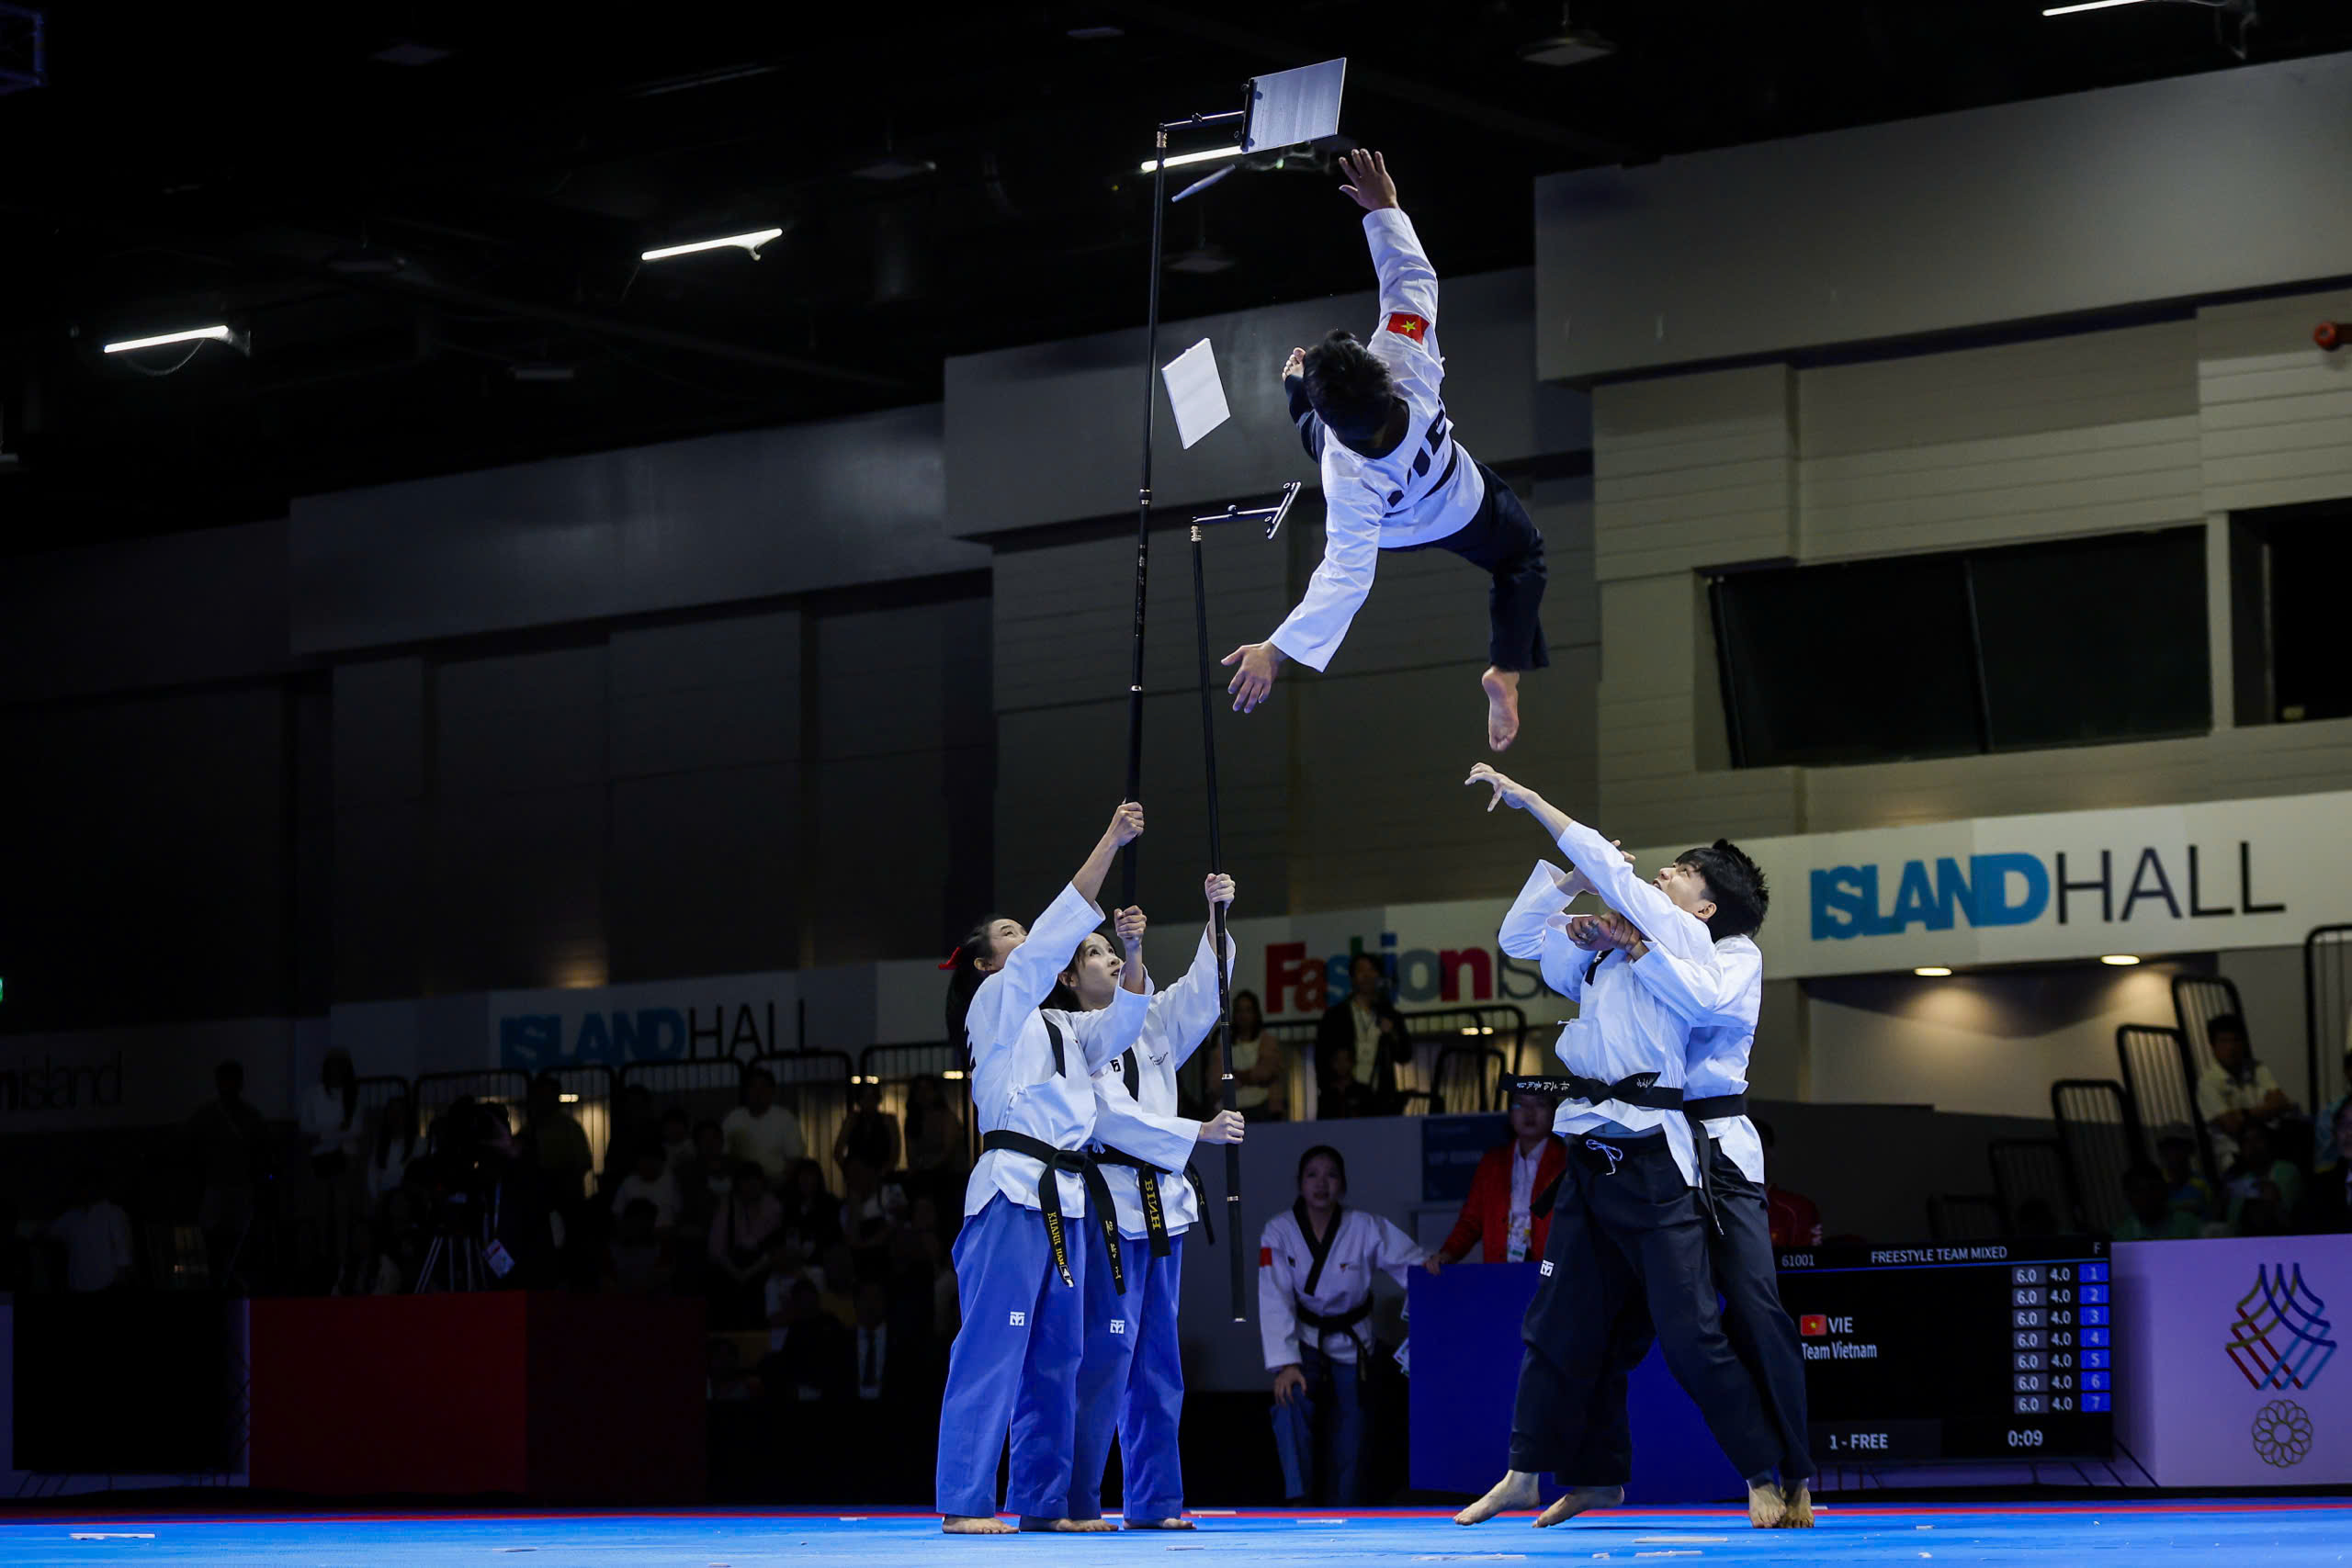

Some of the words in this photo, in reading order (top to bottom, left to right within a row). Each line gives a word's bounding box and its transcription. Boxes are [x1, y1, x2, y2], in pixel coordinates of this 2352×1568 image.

[1810, 852, 2049, 940] ISLAND
[2057, 841, 2286, 924] HALL
[500, 1008, 685, 1072] ISLAND
[690, 998, 820, 1061] HALL
[1781, 1254, 1815, 1268] 61001
[1871, 1248, 1934, 1264] FREESTYLE
[1937, 1247, 1969, 1261] TEAM
[1971, 1246, 2007, 1259] MIXED
[2016, 1269, 2037, 1283] 6.0
[2049, 1267, 2071, 1281] 4.0
[2089, 1266, 2099, 1280] 1
[2017, 1291, 2037, 1304] 6.0
[2050, 1289, 2071, 1303] 4.0
[2089, 1287, 2099, 1302] 2
[1827, 1316, 1854, 1335] VIE
[2017, 1312, 2038, 1325] 6.0
[2050, 1310, 2072, 1324] 4.0
[2090, 1308, 2099, 1323] 3
[2018, 1333, 2038, 1347] 6.0
[2051, 1331, 2072, 1345] 4.0
[2090, 1329, 2100, 1344] 4
[1802, 1342, 1830, 1360] Team
[1831, 1340, 1878, 1359] Vietnam
[2018, 1355, 2039, 1369] 6.0
[2051, 1353, 2073, 1367] 4.0
[2091, 1351, 2100, 1366] 5
[2018, 1376, 2039, 1390] 6.0
[2052, 1374, 2073, 1388] 4.0
[2091, 1372, 2100, 1387] 6
[2018, 1397, 2040, 1412] 6.0
[2052, 1395, 2074, 1410] 4.0
[2092, 1393, 2101, 1409] 7
[1830, 1434, 1838, 1450] 1
[1850, 1433, 1889, 1450] FREE
[2007, 1428, 2043, 1448] 0:09
